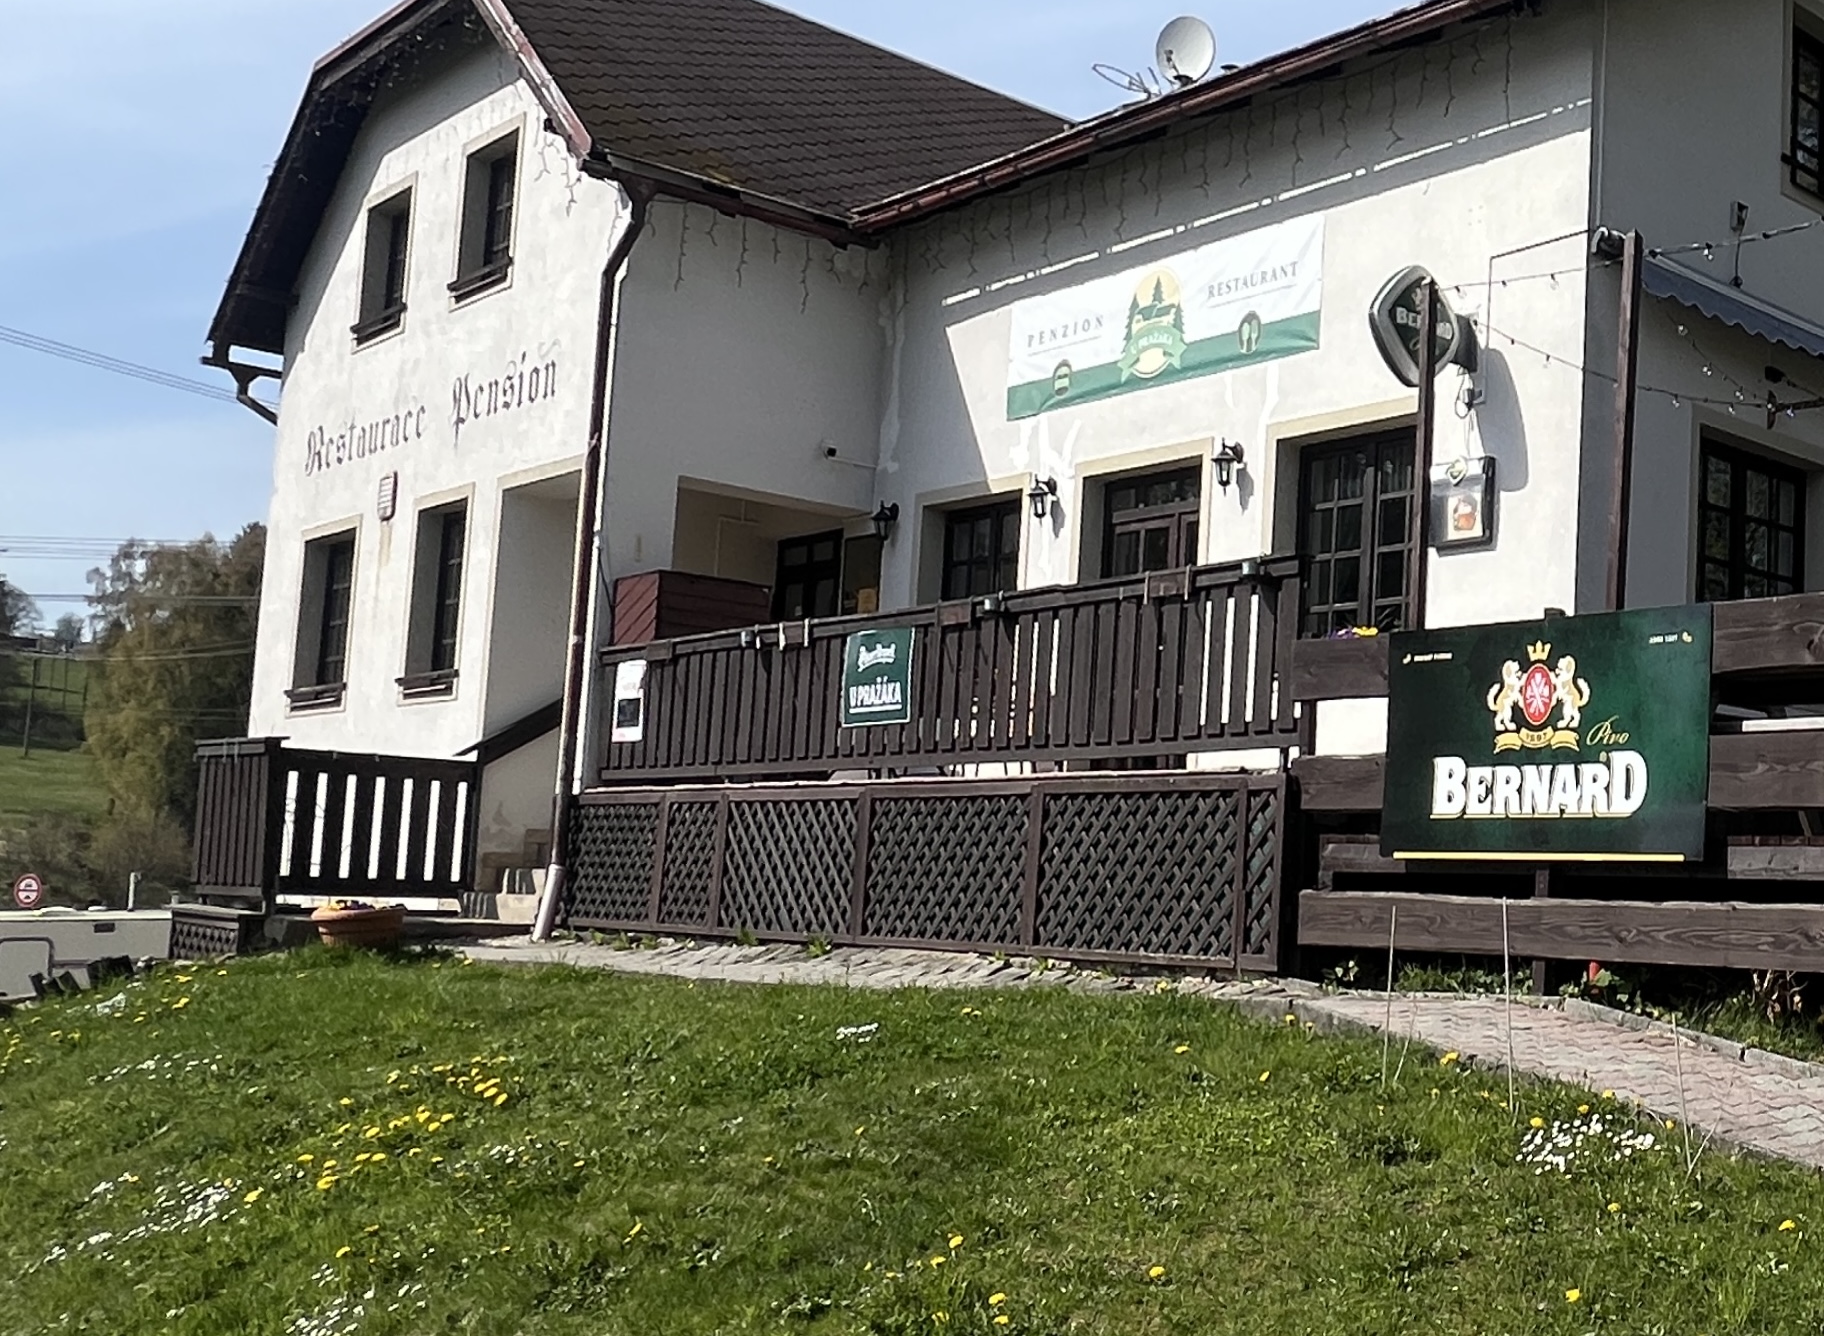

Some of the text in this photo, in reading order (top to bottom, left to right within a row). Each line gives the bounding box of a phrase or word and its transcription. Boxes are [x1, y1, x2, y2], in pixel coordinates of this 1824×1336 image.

[1206, 261, 1299, 301] RESTAURANT
[1027, 315, 1104, 348] PENZION
[304, 403, 427, 477] Restaurace
[1585, 715, 1631, 746] Pivo
[1429, 749, 1648, 820] BERNARD
